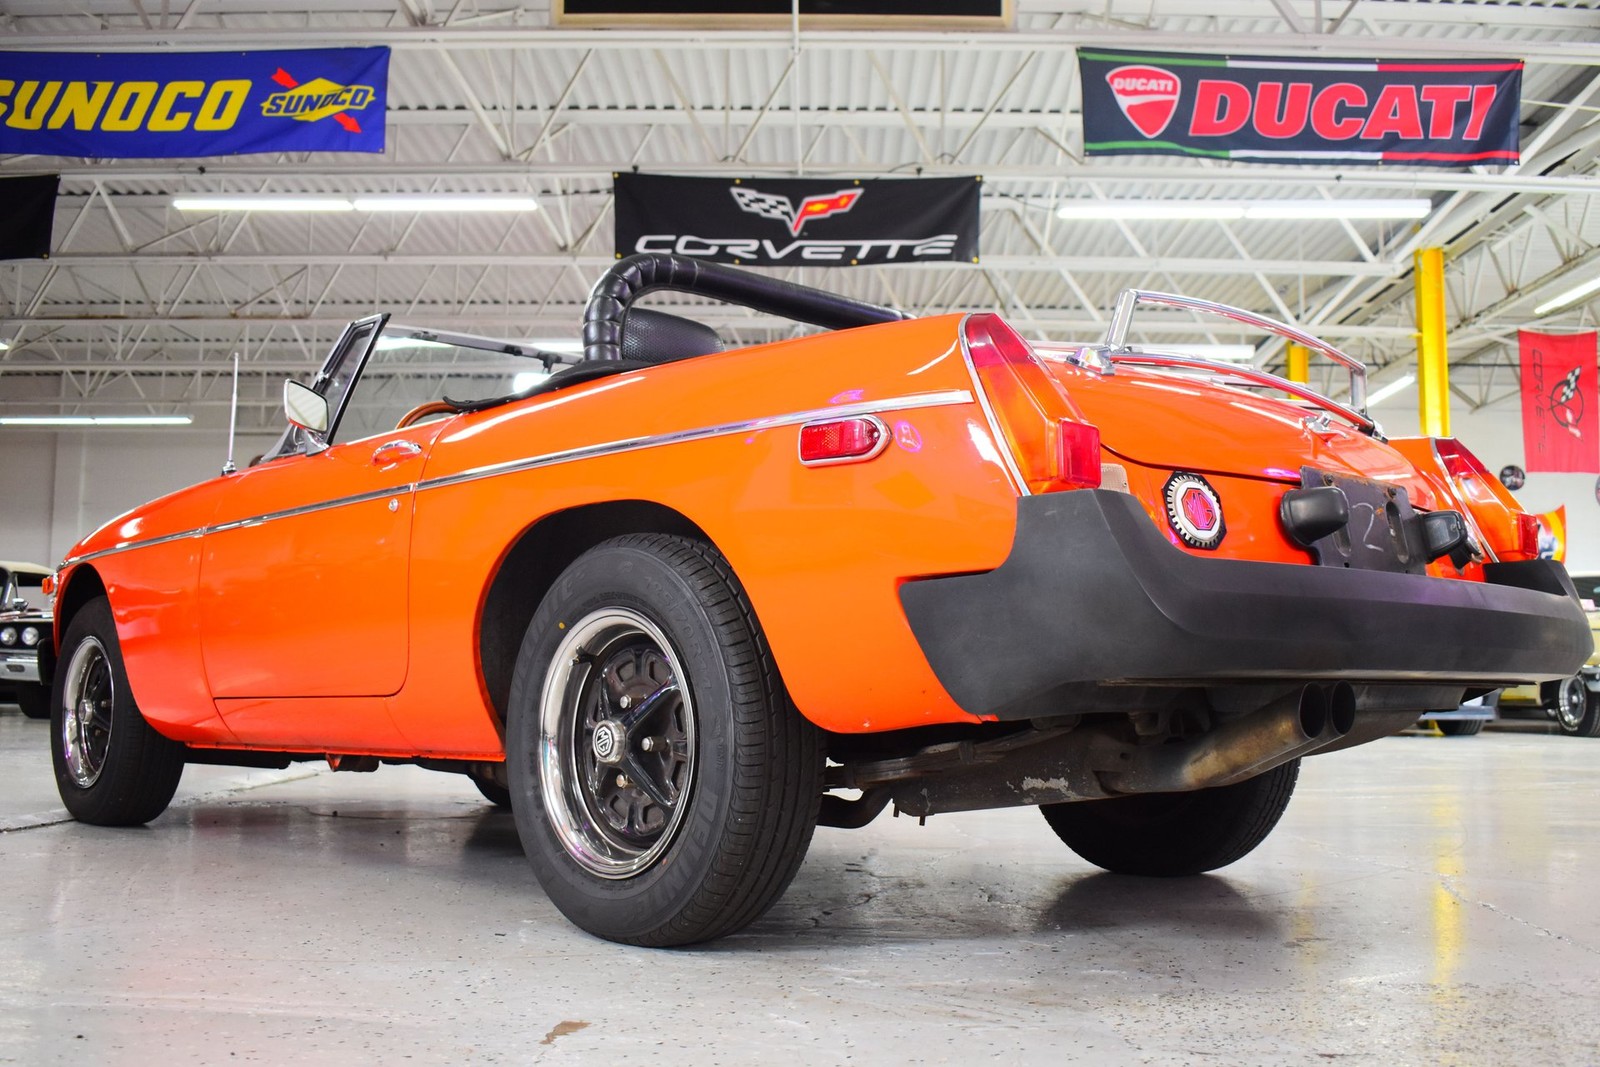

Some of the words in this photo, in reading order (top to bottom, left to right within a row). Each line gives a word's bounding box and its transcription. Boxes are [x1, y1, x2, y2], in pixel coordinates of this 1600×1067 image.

[265, 87, 371, 114] SUNOCO
[1113, 77, 1174, 92] DUCATI
[0, 79, 252, 132] UNOCO
[1188, 79, 1497, 140] DUCATI
[635, 234, 958, 260] CORVETTE
[1532, 348, 1547, 455] CORVETTE
[1184, 490, 1214, 528] MG
[1351, 502, 1384, 553] 2
[597, 729, 611, 753] MG
